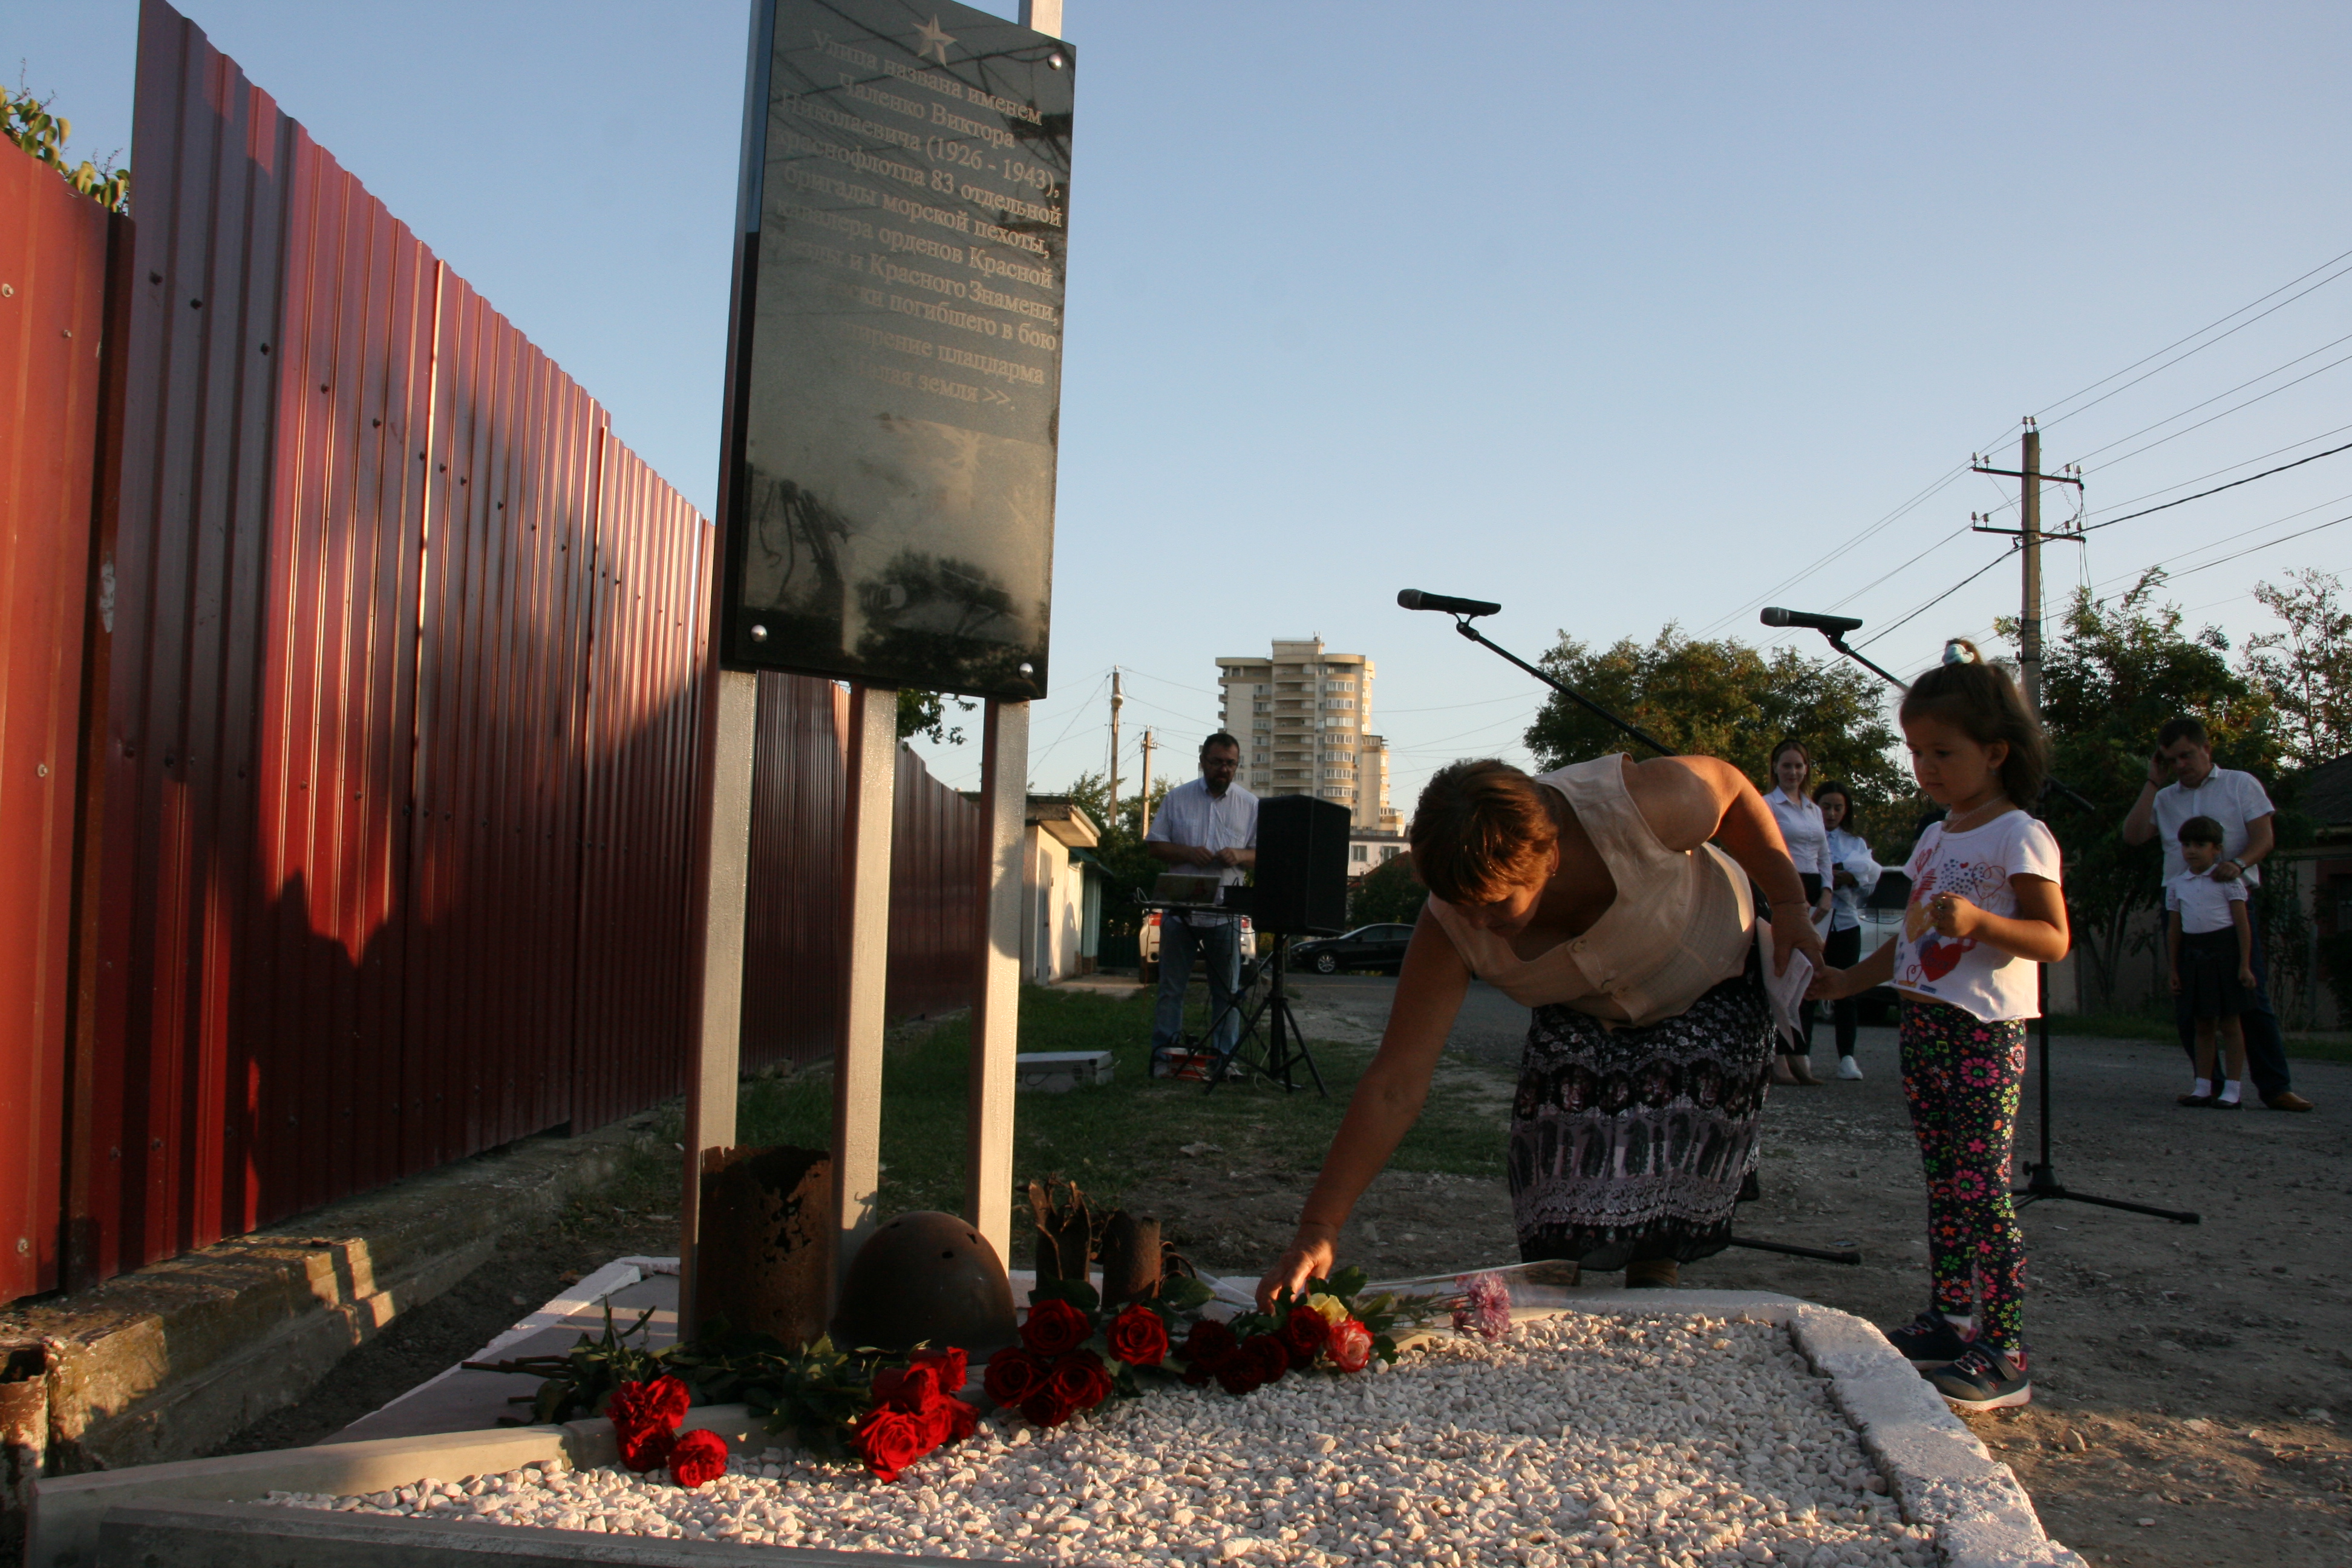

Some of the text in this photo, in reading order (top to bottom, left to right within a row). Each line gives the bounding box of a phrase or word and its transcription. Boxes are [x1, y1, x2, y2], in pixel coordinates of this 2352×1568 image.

[812, 30, 1042, 125] Улица названа именем
[839, 73, 1014, 149] Чаленко Виктора
[775, 128, 1060, 226] краснофлотца 83 отдельной
[780, 90, 920, 151] Николаевича
[928, 136, 982, 171] (1926
[1004, 160, 1059, 197] 1943),
[778, 199, 1053, 289] кавалера орденов Красной
[785, 163, 1048, 258] бригады морской пехоты,
[850, 256, 864, 270] и
[870, 254, 965, 298] Красного
[970, 283, 1058, 325] Знамени,
[891, 295, 1056, 350] погибшего в бою
[918, 374, 978, 402] земля
[939, 345, 1044, 385] плацдарма
